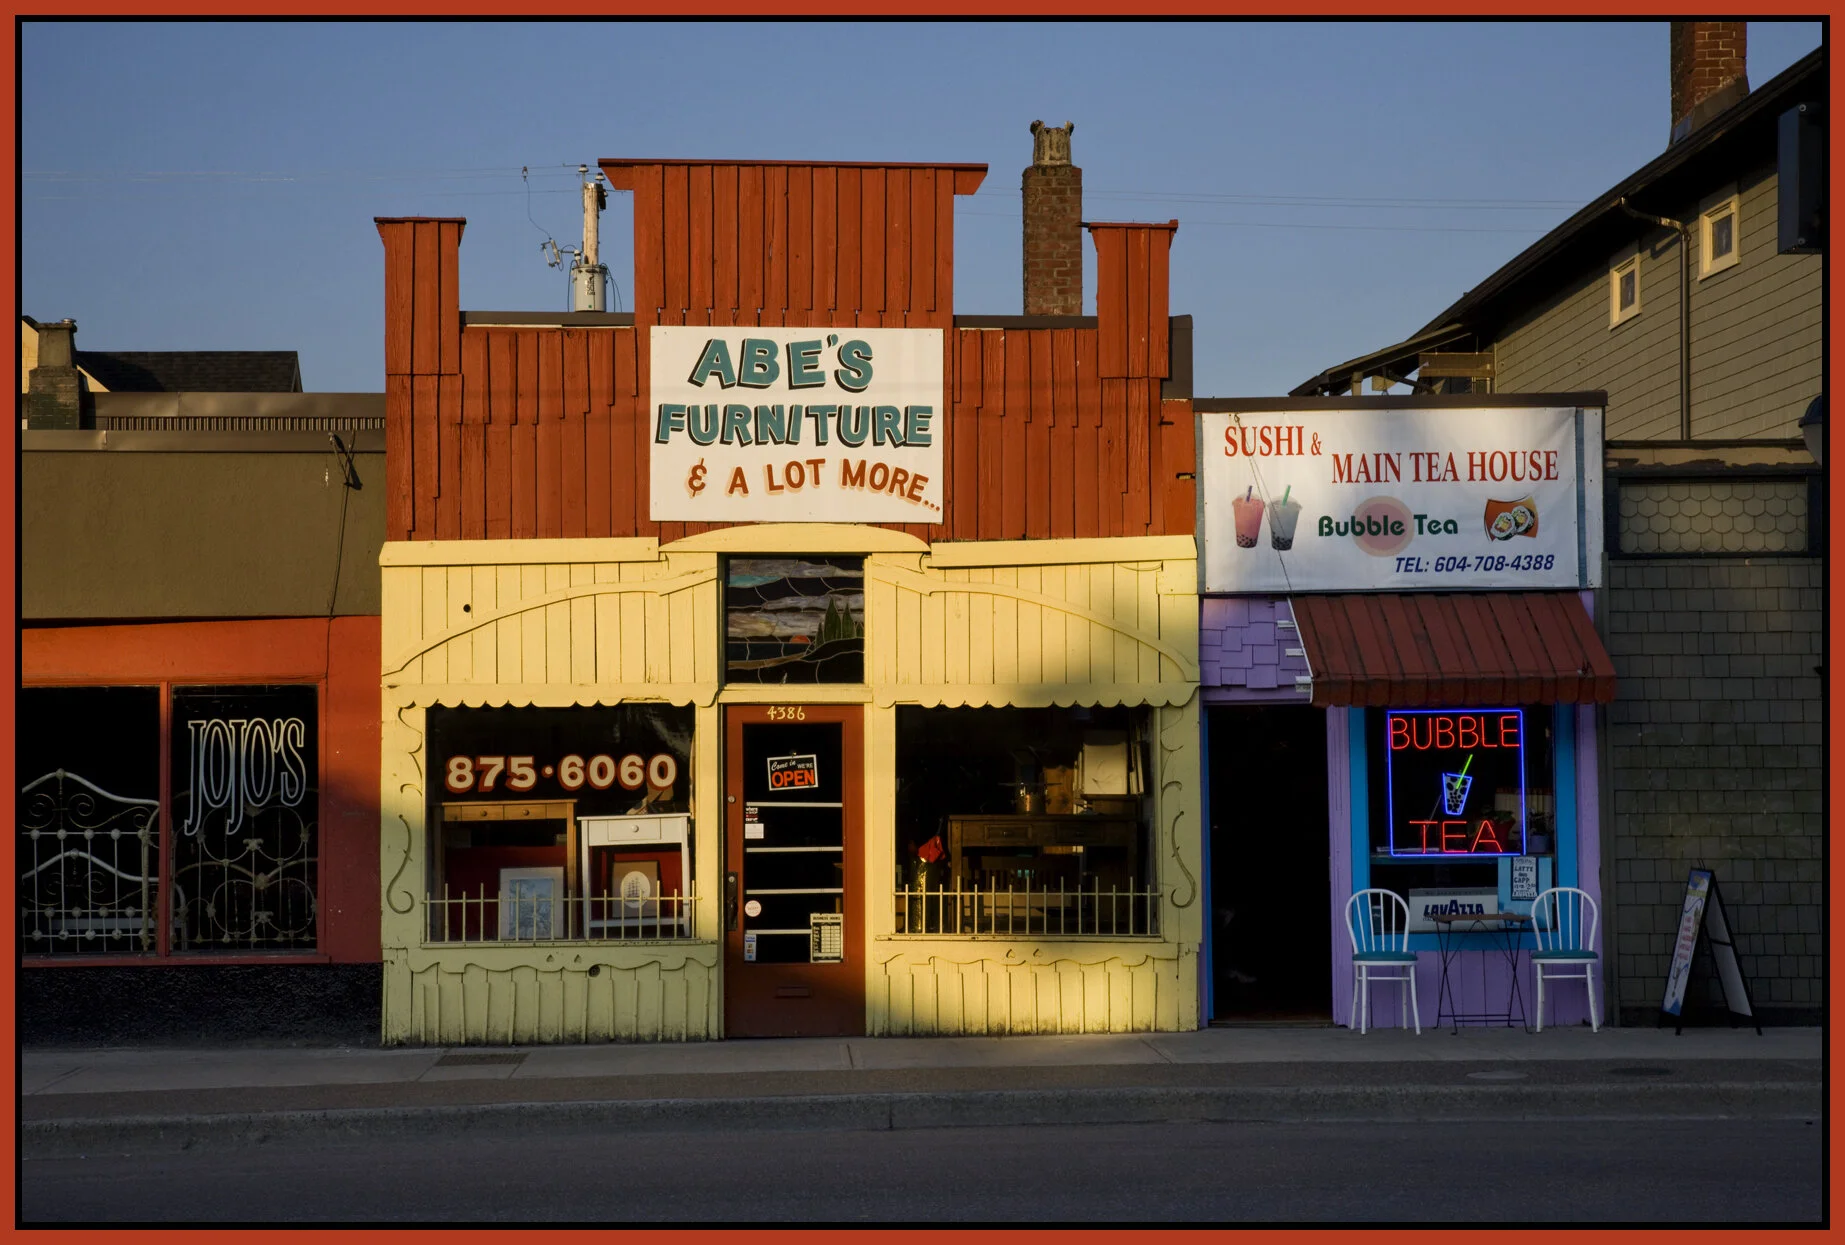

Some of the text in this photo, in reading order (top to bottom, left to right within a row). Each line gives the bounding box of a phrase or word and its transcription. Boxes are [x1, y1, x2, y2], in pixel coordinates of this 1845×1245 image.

[688, 334, 873, 393] ABE'S
[655, 403, 933, 448] FURNITURE
[1224, 425, 1322, 457] SUSHI &
[687, 458, 708, 497] &
[728, 466, 750, 495] A
[766, 458, 826, 492] LOT
[1332, 450, 1559, 484] MAIN TEA HOUSE
[1318, 514, 1458, 537] Bubble Tea
[1395, 554, 1555, 573] TEL: 604-708-4388
[767, 705, 806, 721] 4386
[1389, 715, 1520, 750] BUBBLE
[184, 717, 306, 836] JOJO'S
[771, 761, 789, 772] Come
[789, 759, 797, 767] in
[771, 769, 815, 788] OPEN
[1408, 819, 1503, 854] TEA
